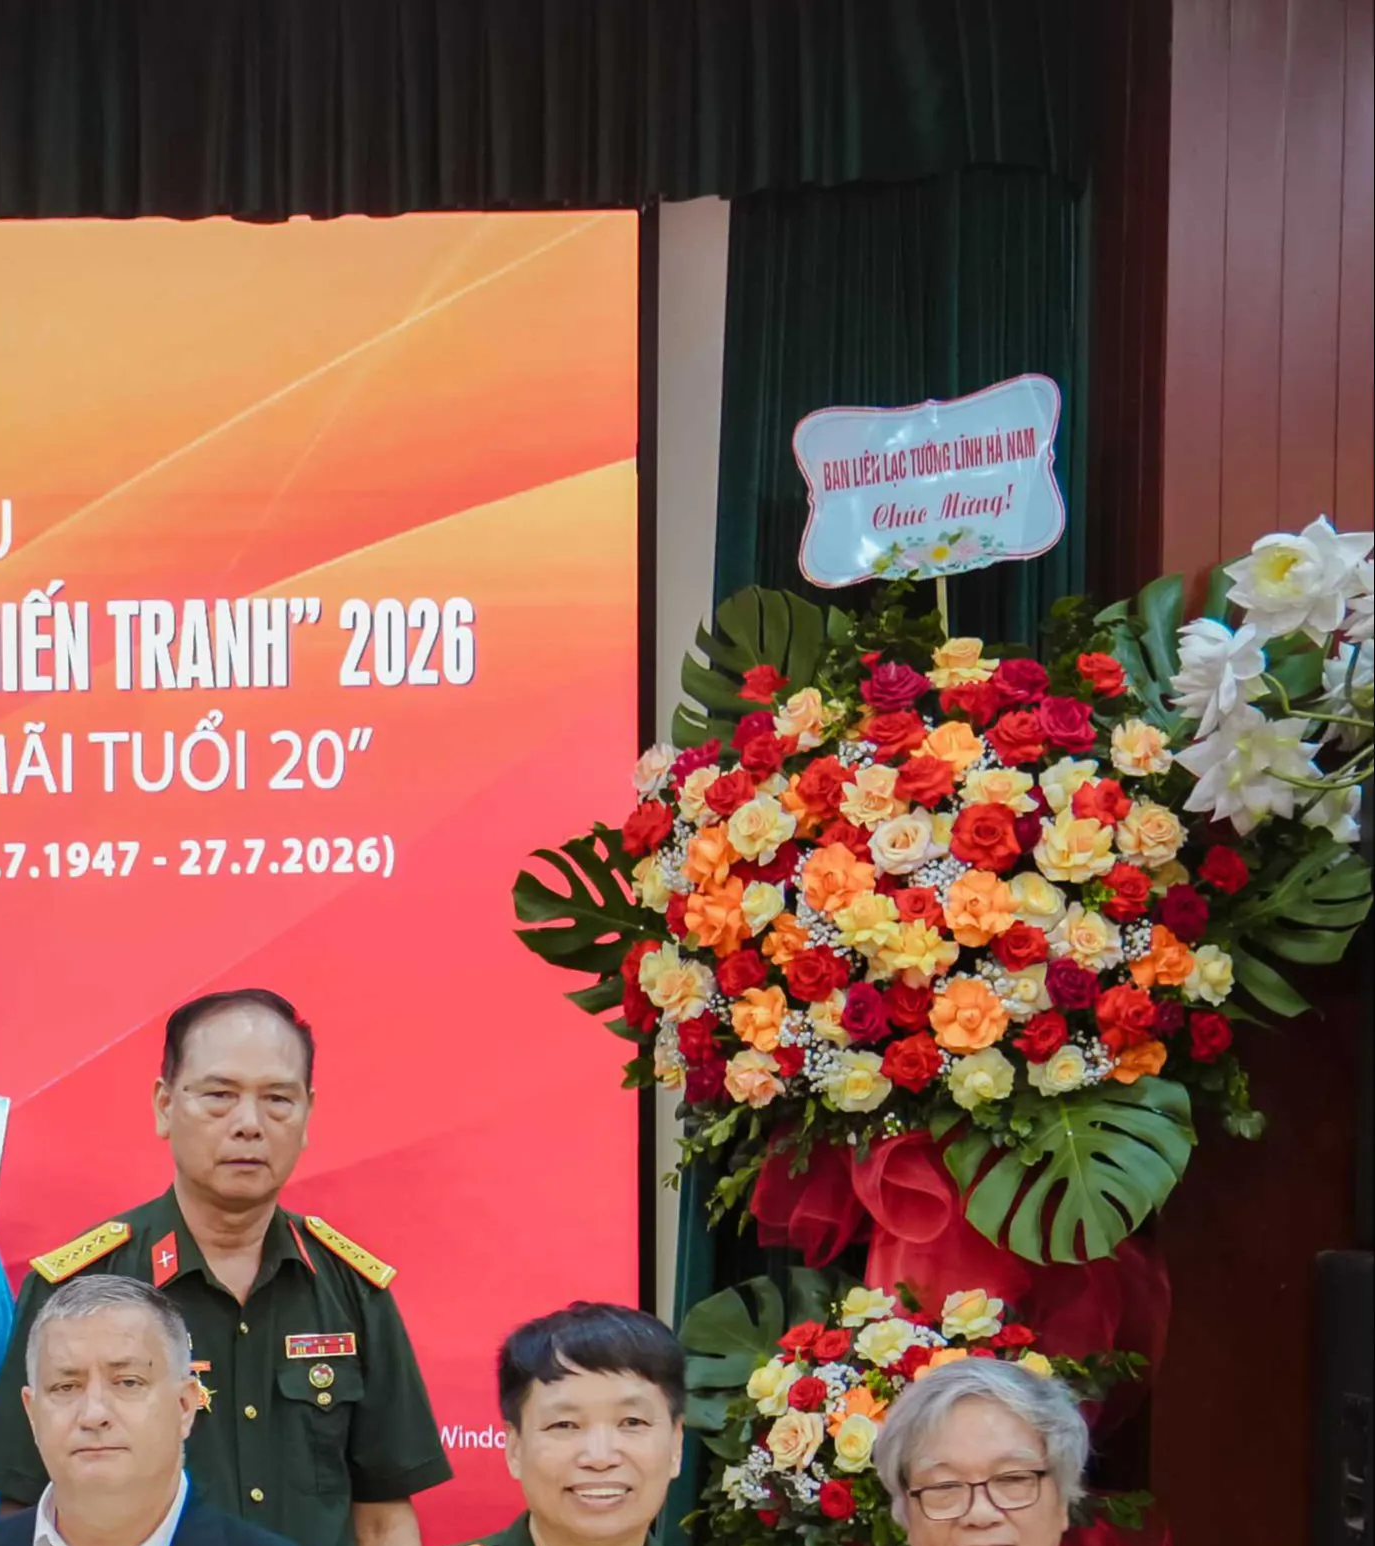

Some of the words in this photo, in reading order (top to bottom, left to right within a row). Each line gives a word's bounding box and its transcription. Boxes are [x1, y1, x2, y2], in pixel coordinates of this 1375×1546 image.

[823, 458, 850, 491] BAN
[853, 449, 881, 485] LIÊN
[883, 450, 907, 488] LẠC
[910, 440, 951, 478] TƯỚNG
[1007, 427, 1036, 461] NAM
[872, 502, 928, 530] Chúc
[935, 483, 1014, 521] Mừng!
[340, 597, 474, 686] 2026
[88, 711, 245, 793] TUỔI
[153, 857, 167, 865] -
[179, 834, 395, 877] 27.7.2026)
